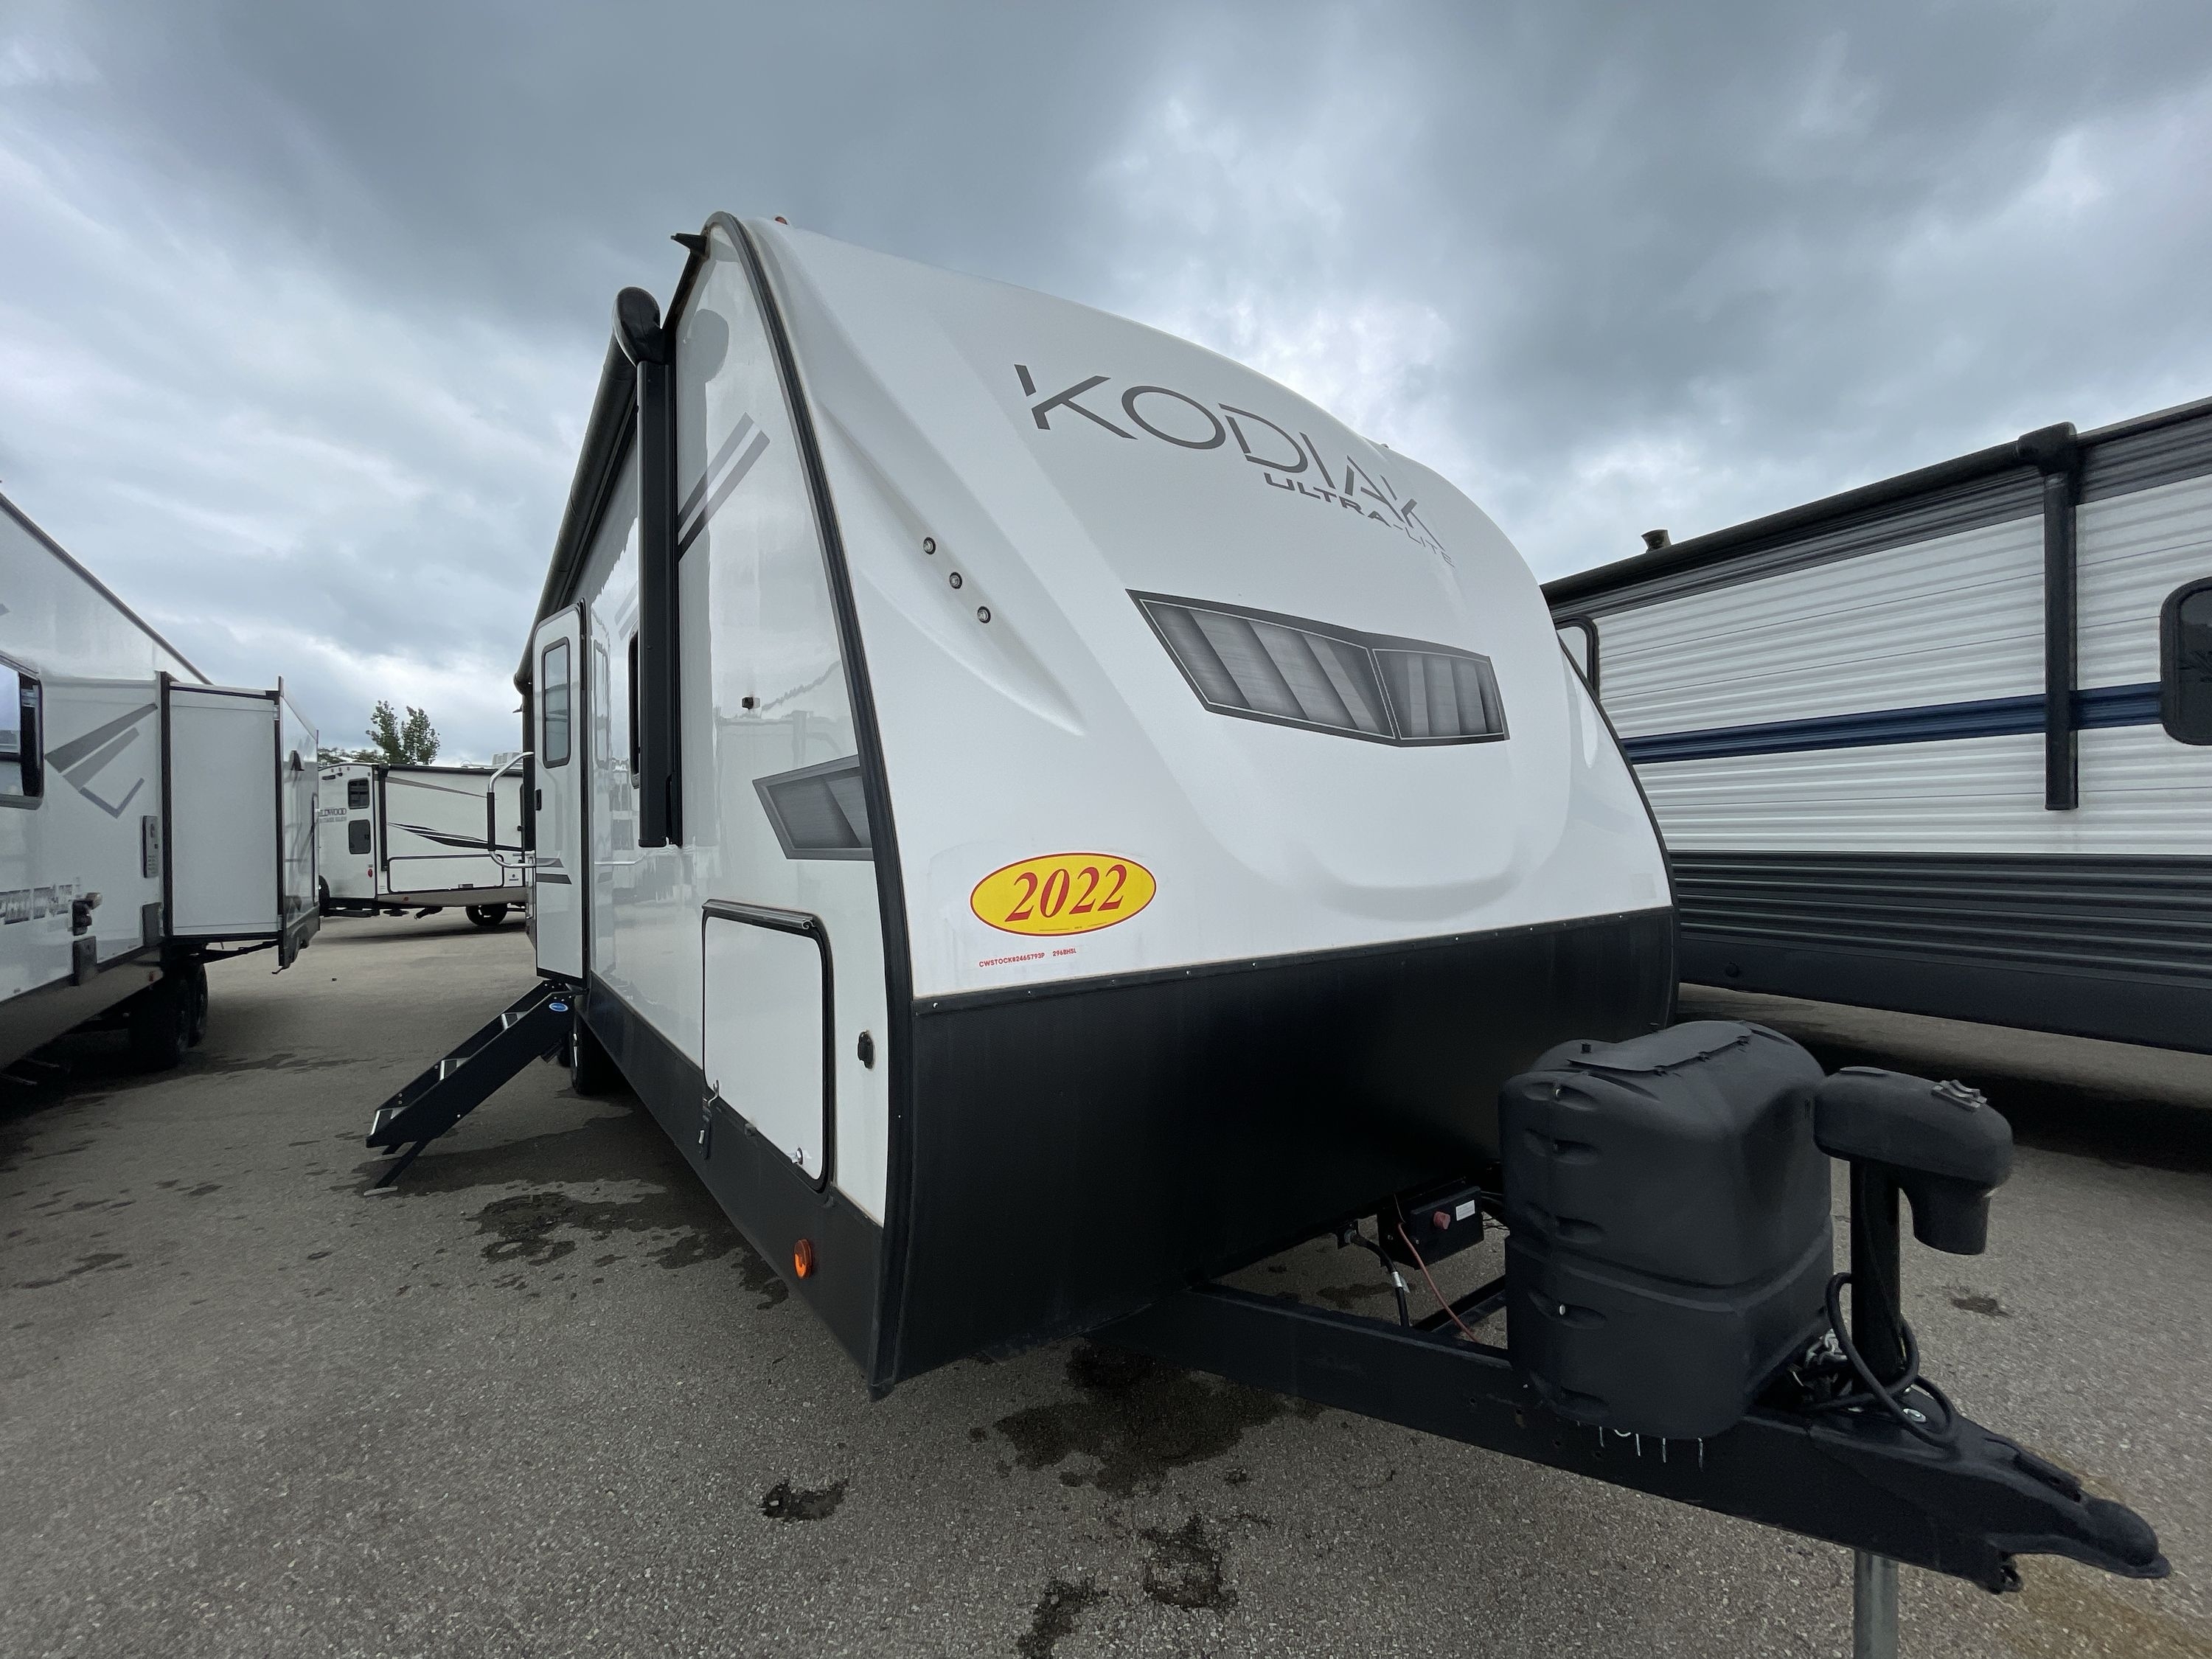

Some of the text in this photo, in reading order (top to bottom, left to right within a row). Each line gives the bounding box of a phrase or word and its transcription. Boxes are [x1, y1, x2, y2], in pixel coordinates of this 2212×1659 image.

[1013, 364, 1446, 552] KODIAK
[1263, 472, 1455, 568] ULTRA-LITE
[1004, 863, 1127, 922] 2022
